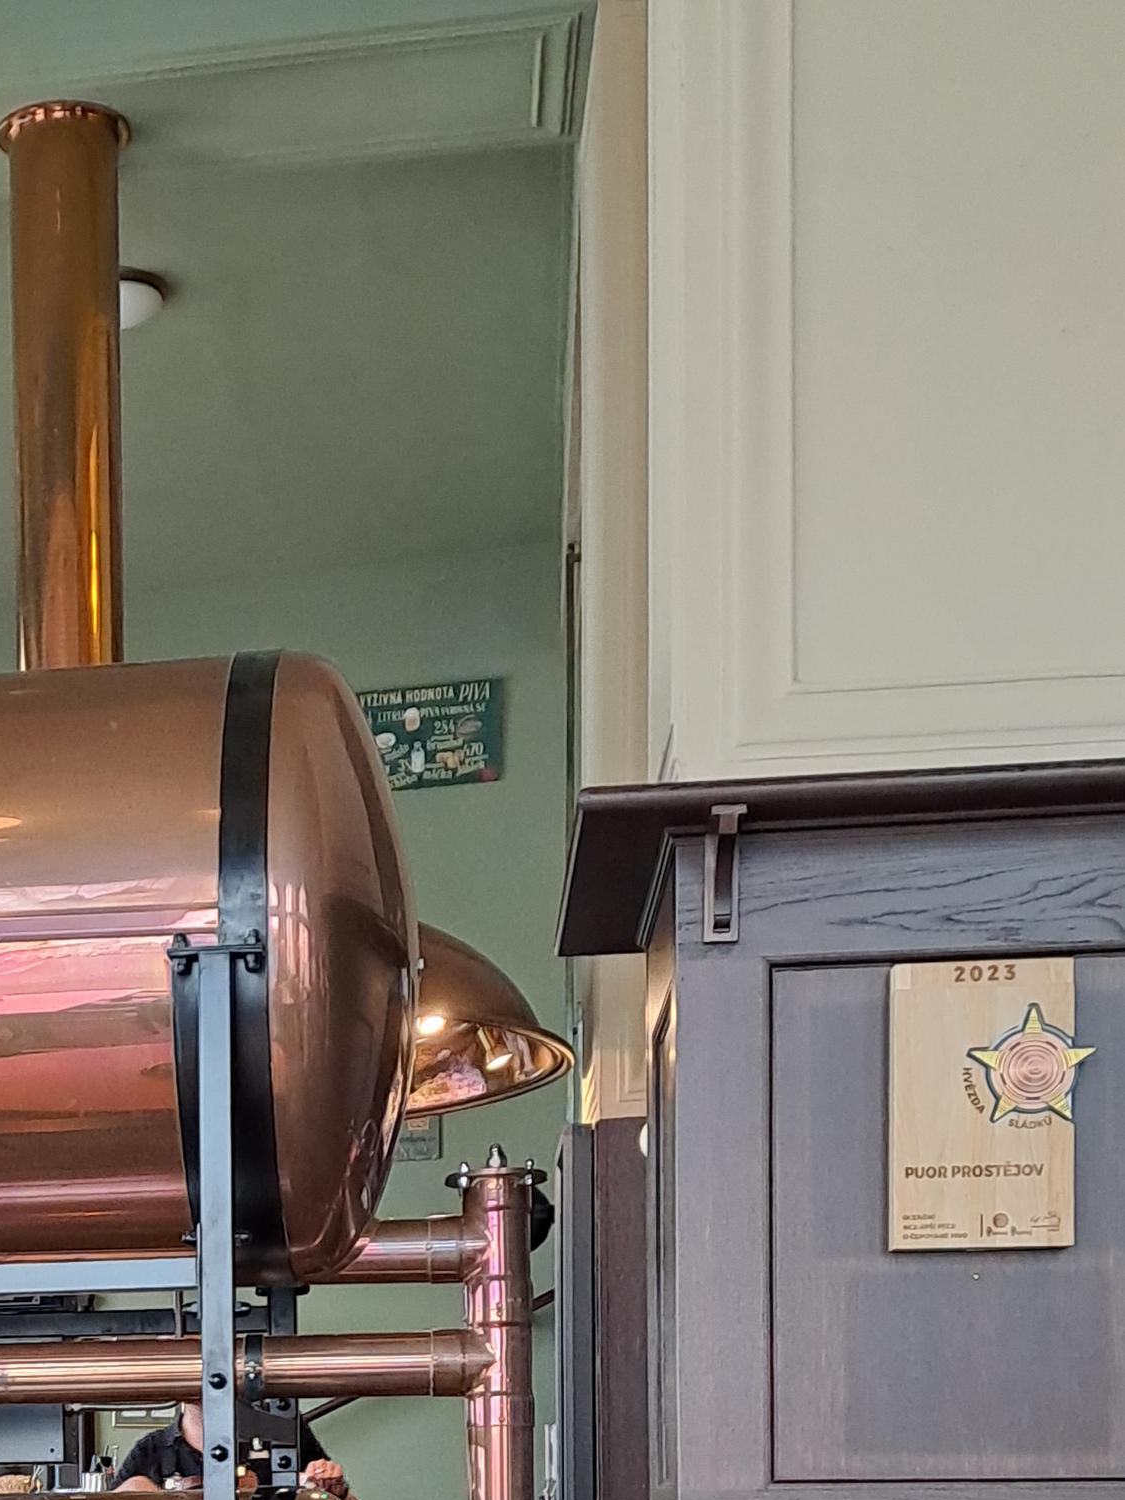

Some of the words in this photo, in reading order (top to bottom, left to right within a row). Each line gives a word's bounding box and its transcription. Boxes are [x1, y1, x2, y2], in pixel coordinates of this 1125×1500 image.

[405, 686, 455, 703] HODNOTA
[458, 681, 491, 702] PIVA
[953, 964, 1017, 982] 2023
[962, 1067, 986, 1114] HVĚZDA
[904, 1165, 948, 1179] PUOR
[951, 1160, 1044, 1178] PROSTĚJOV
